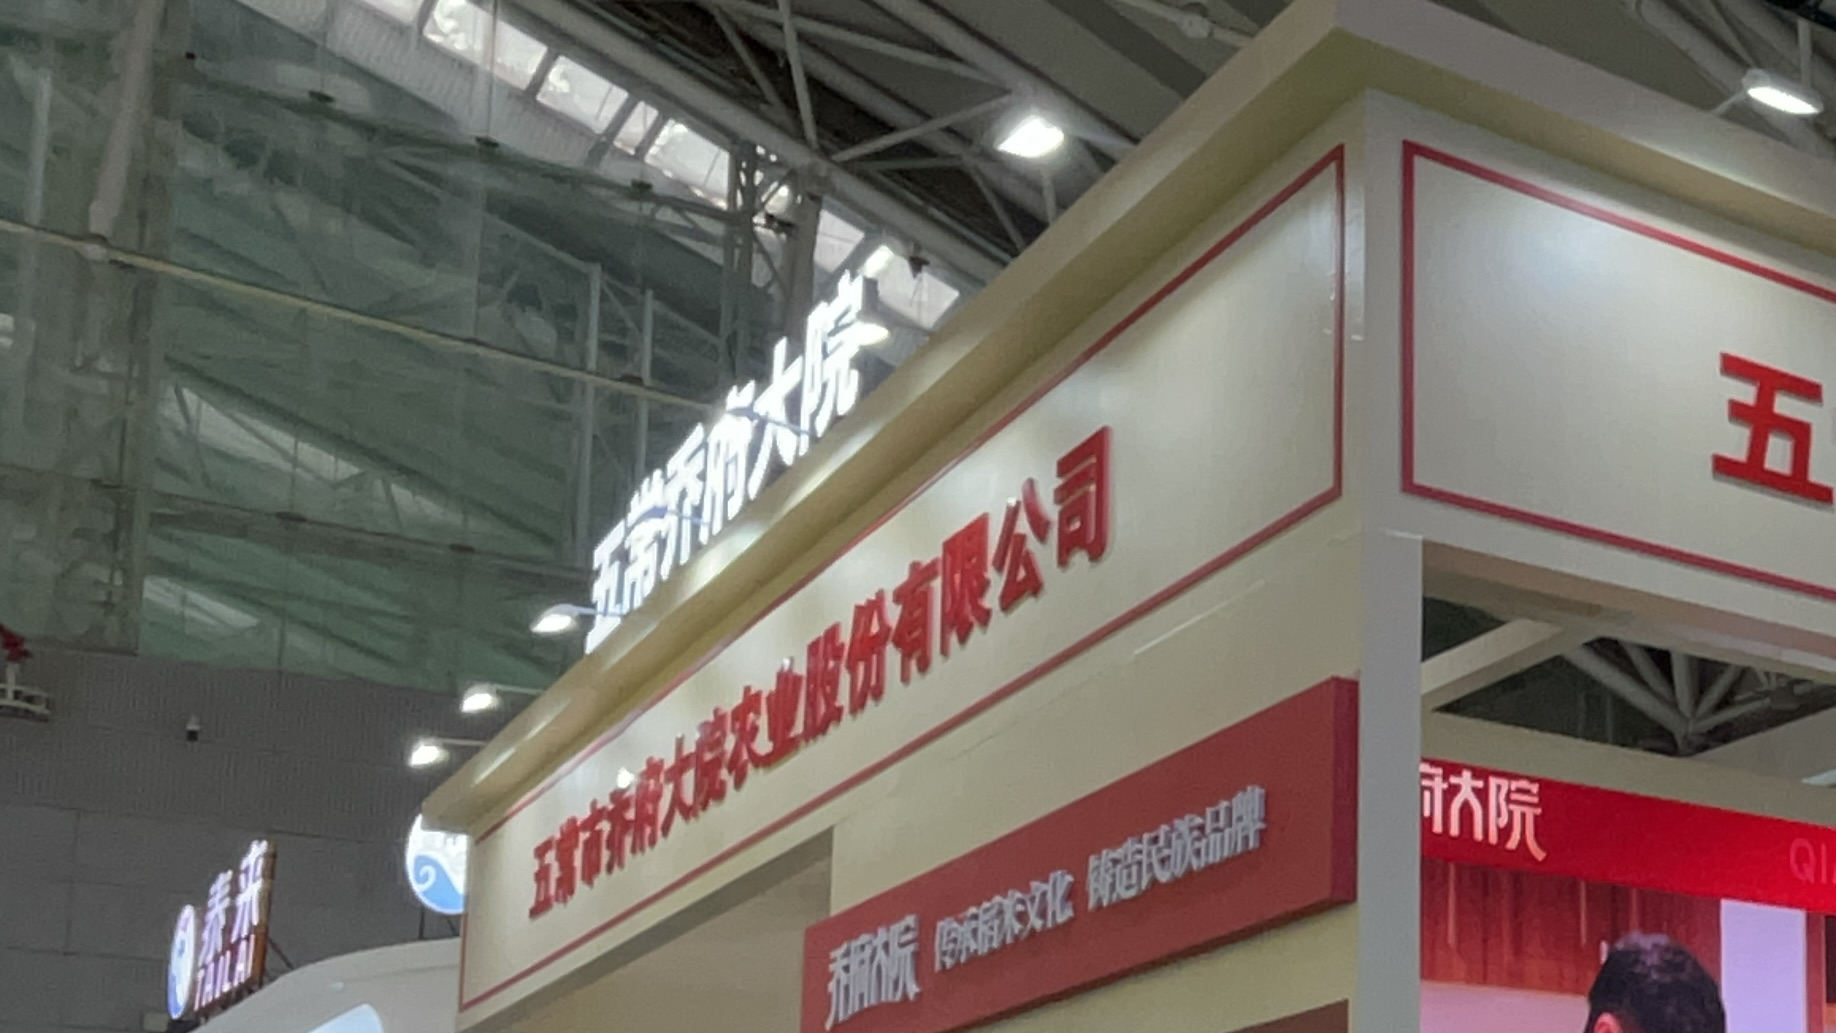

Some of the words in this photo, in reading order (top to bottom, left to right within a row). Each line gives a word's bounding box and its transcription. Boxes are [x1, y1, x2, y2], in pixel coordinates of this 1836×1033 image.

[529, 425, 1112, 918] 五常市乔府大院农业股份有限公司
